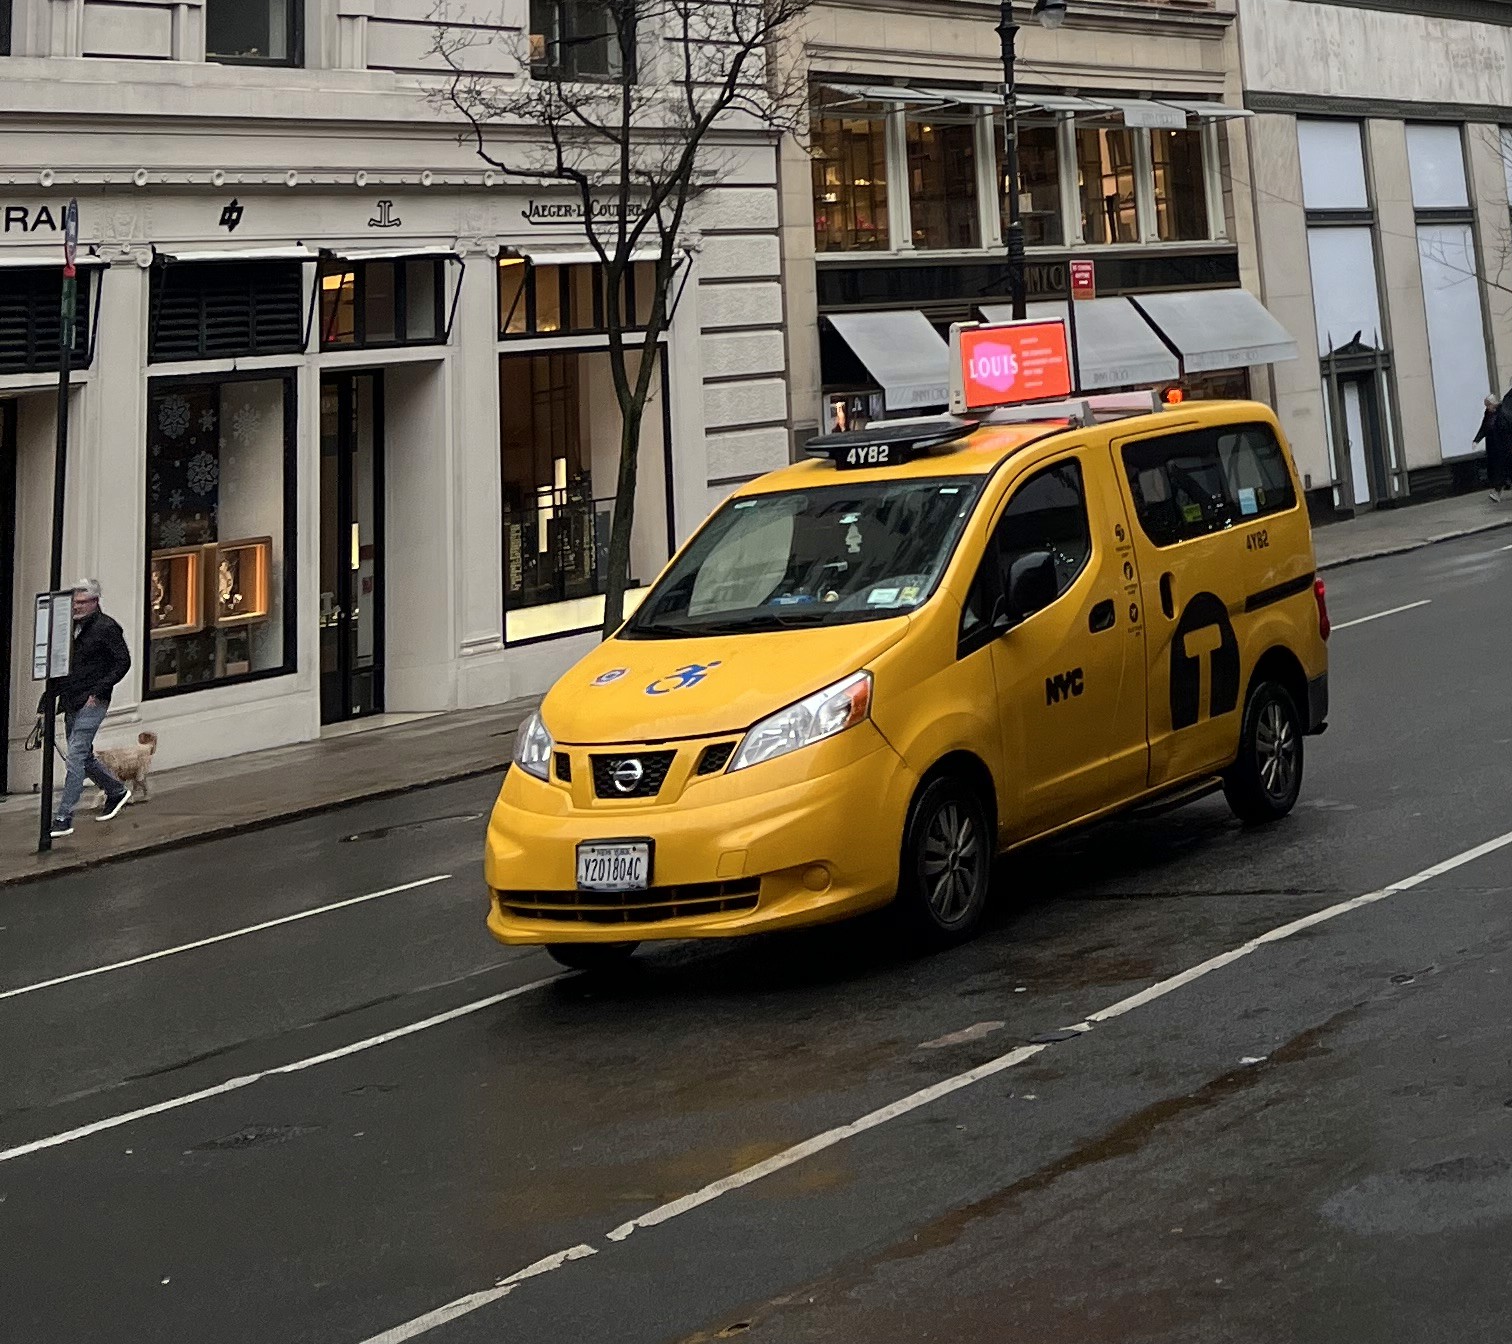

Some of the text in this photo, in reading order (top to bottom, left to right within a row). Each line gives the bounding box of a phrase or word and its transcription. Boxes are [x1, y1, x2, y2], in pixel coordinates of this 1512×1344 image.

[969, 354, 1019, 379] LOUIS
[846, 445, 889, 464] 4Y82
[1045, 667, 1085, 706] NYC
[584, 857, 641, 882] Y201804C
